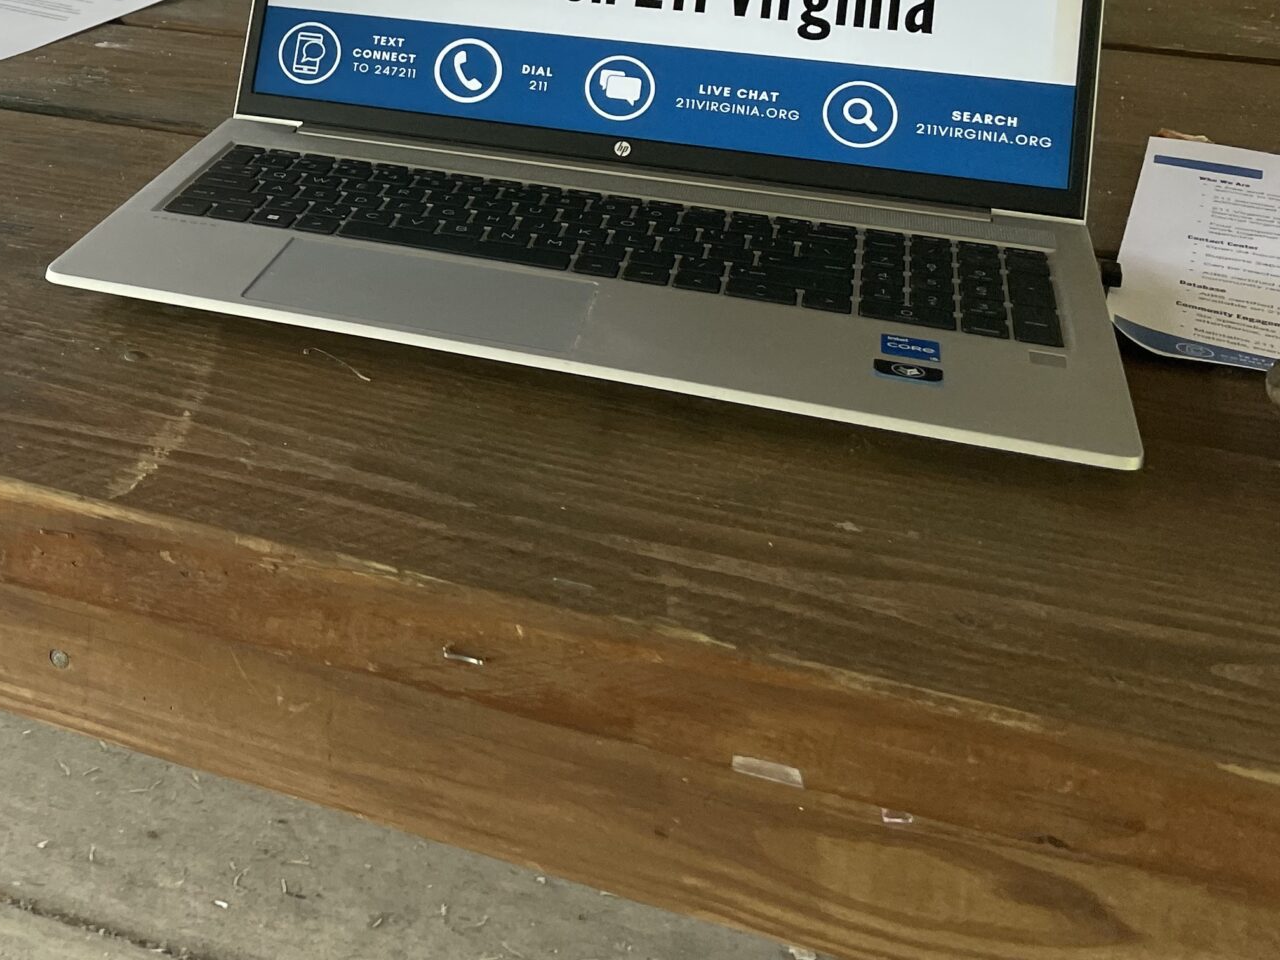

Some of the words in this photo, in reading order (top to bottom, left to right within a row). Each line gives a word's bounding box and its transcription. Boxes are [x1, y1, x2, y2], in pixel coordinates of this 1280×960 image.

[372, 35, 405, 48] TEXT
[352, 48, 417, 64] CONNECT
[353, 61, 369, 73] TO
[374, 64, 417, 79] 247211
[521, 64, 553, 77] DIAL
[529, 80, 548, 92] 211
[698, 84, 732, 97] LIVE
[736, 88, 780, 102] CHAT
[675, 97, 800, 121] 211VIRGINIA.ORG
[951, 110, 1018, 128] SEARCH
[916, 123, 1052, 148] 211VIRGINIA.ORG
[614, 141, 631, 157] hp
[1179, 279, 1227, 293] Database
[1175, 300, 1234, 318] Community
